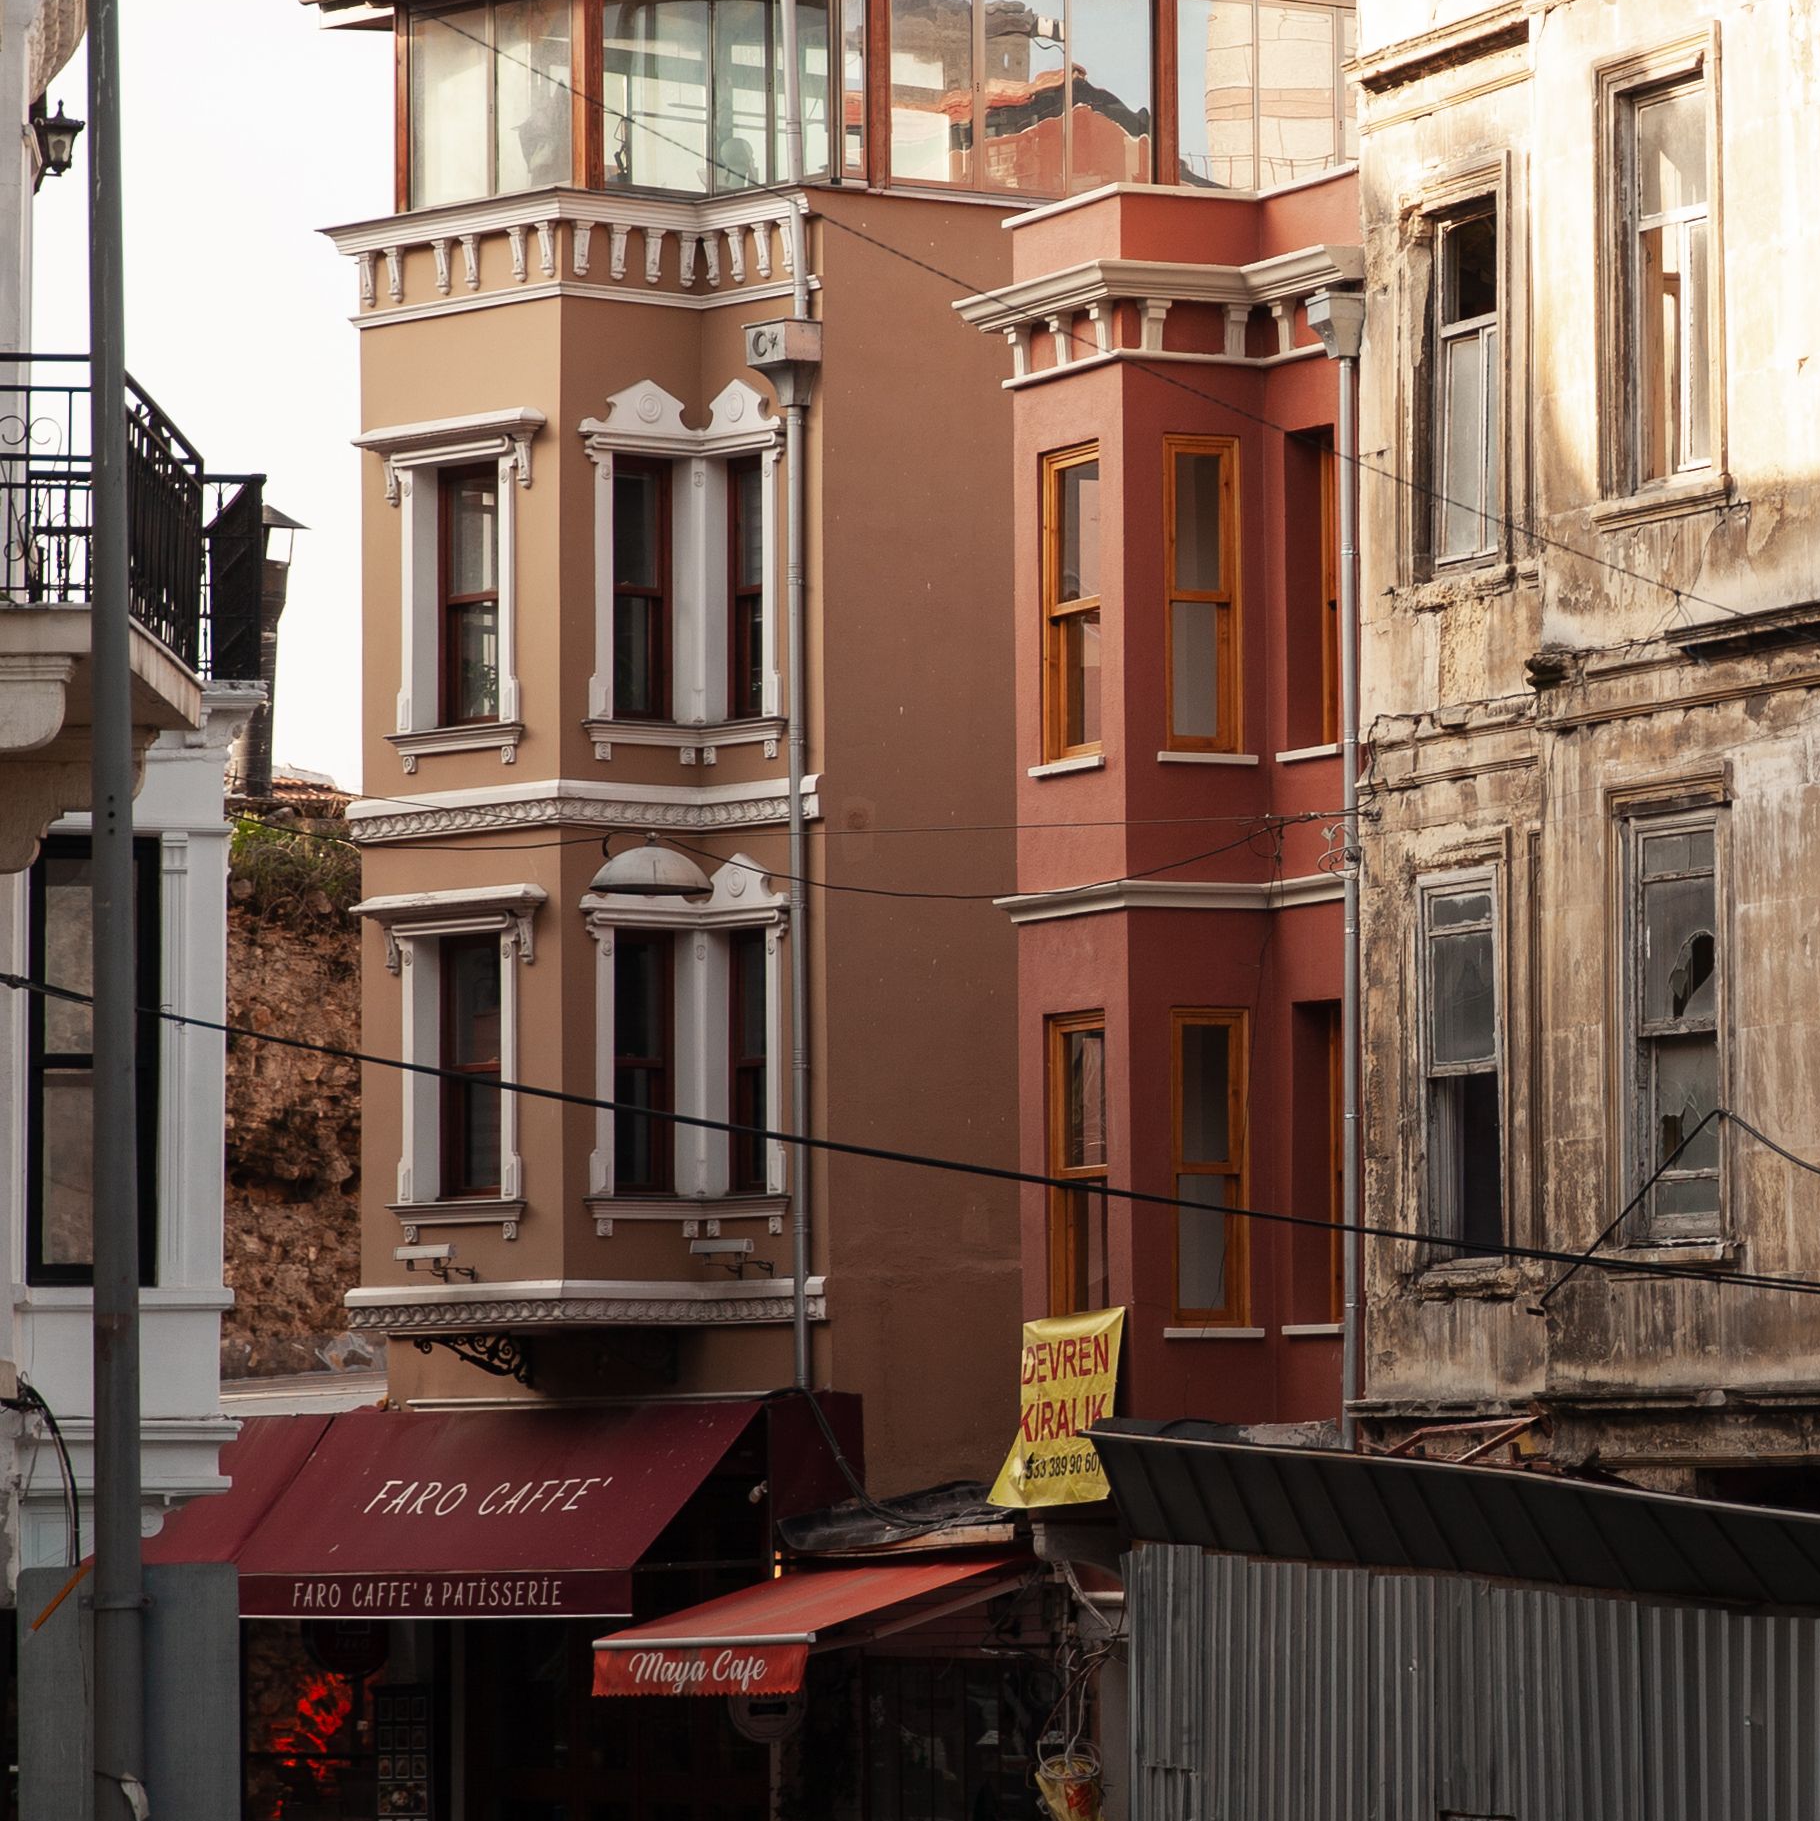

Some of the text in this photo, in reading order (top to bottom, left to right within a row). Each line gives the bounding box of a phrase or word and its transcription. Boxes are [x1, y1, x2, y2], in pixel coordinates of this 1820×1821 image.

[1022, 1333, 1109, 1385] DEVREN
[1020, 1393, 1107, 1442] KİRALIK
[1049, 1456, 1067, 1477] 389
[1069, 1454, 1082, 1474] 90
[363, 1477, 613, 1515] FARO CAFFE'
[293, 1577, 562, 1607] FARO CAFFE' & PATİSSERİE
[628, 1649, 768, 1693] Maya Cafe
